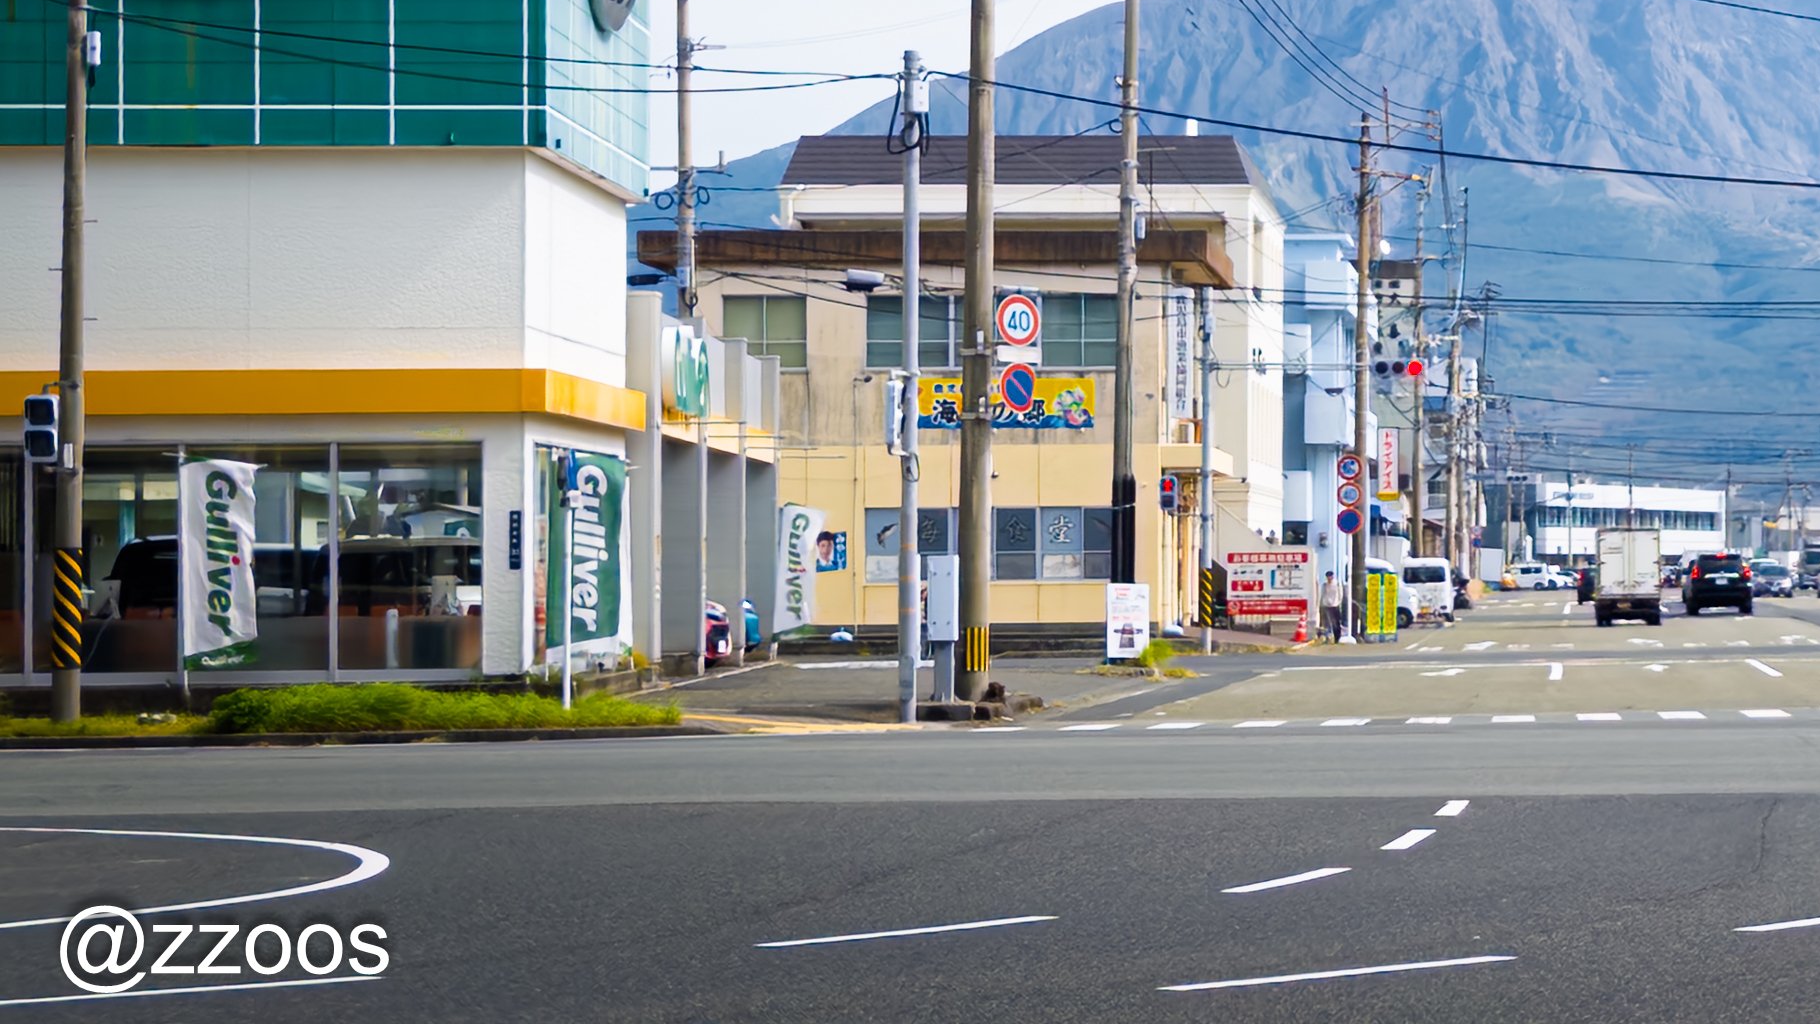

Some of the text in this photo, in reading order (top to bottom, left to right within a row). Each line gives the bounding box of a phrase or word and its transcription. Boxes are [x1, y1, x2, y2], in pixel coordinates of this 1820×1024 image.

[1008, 310, 1030, 332] 40
[206, 470, 238, 637] Gulliver
[573, 464, 608, 633] Gulliver
[786, 512, 810, 621] Gulliver
